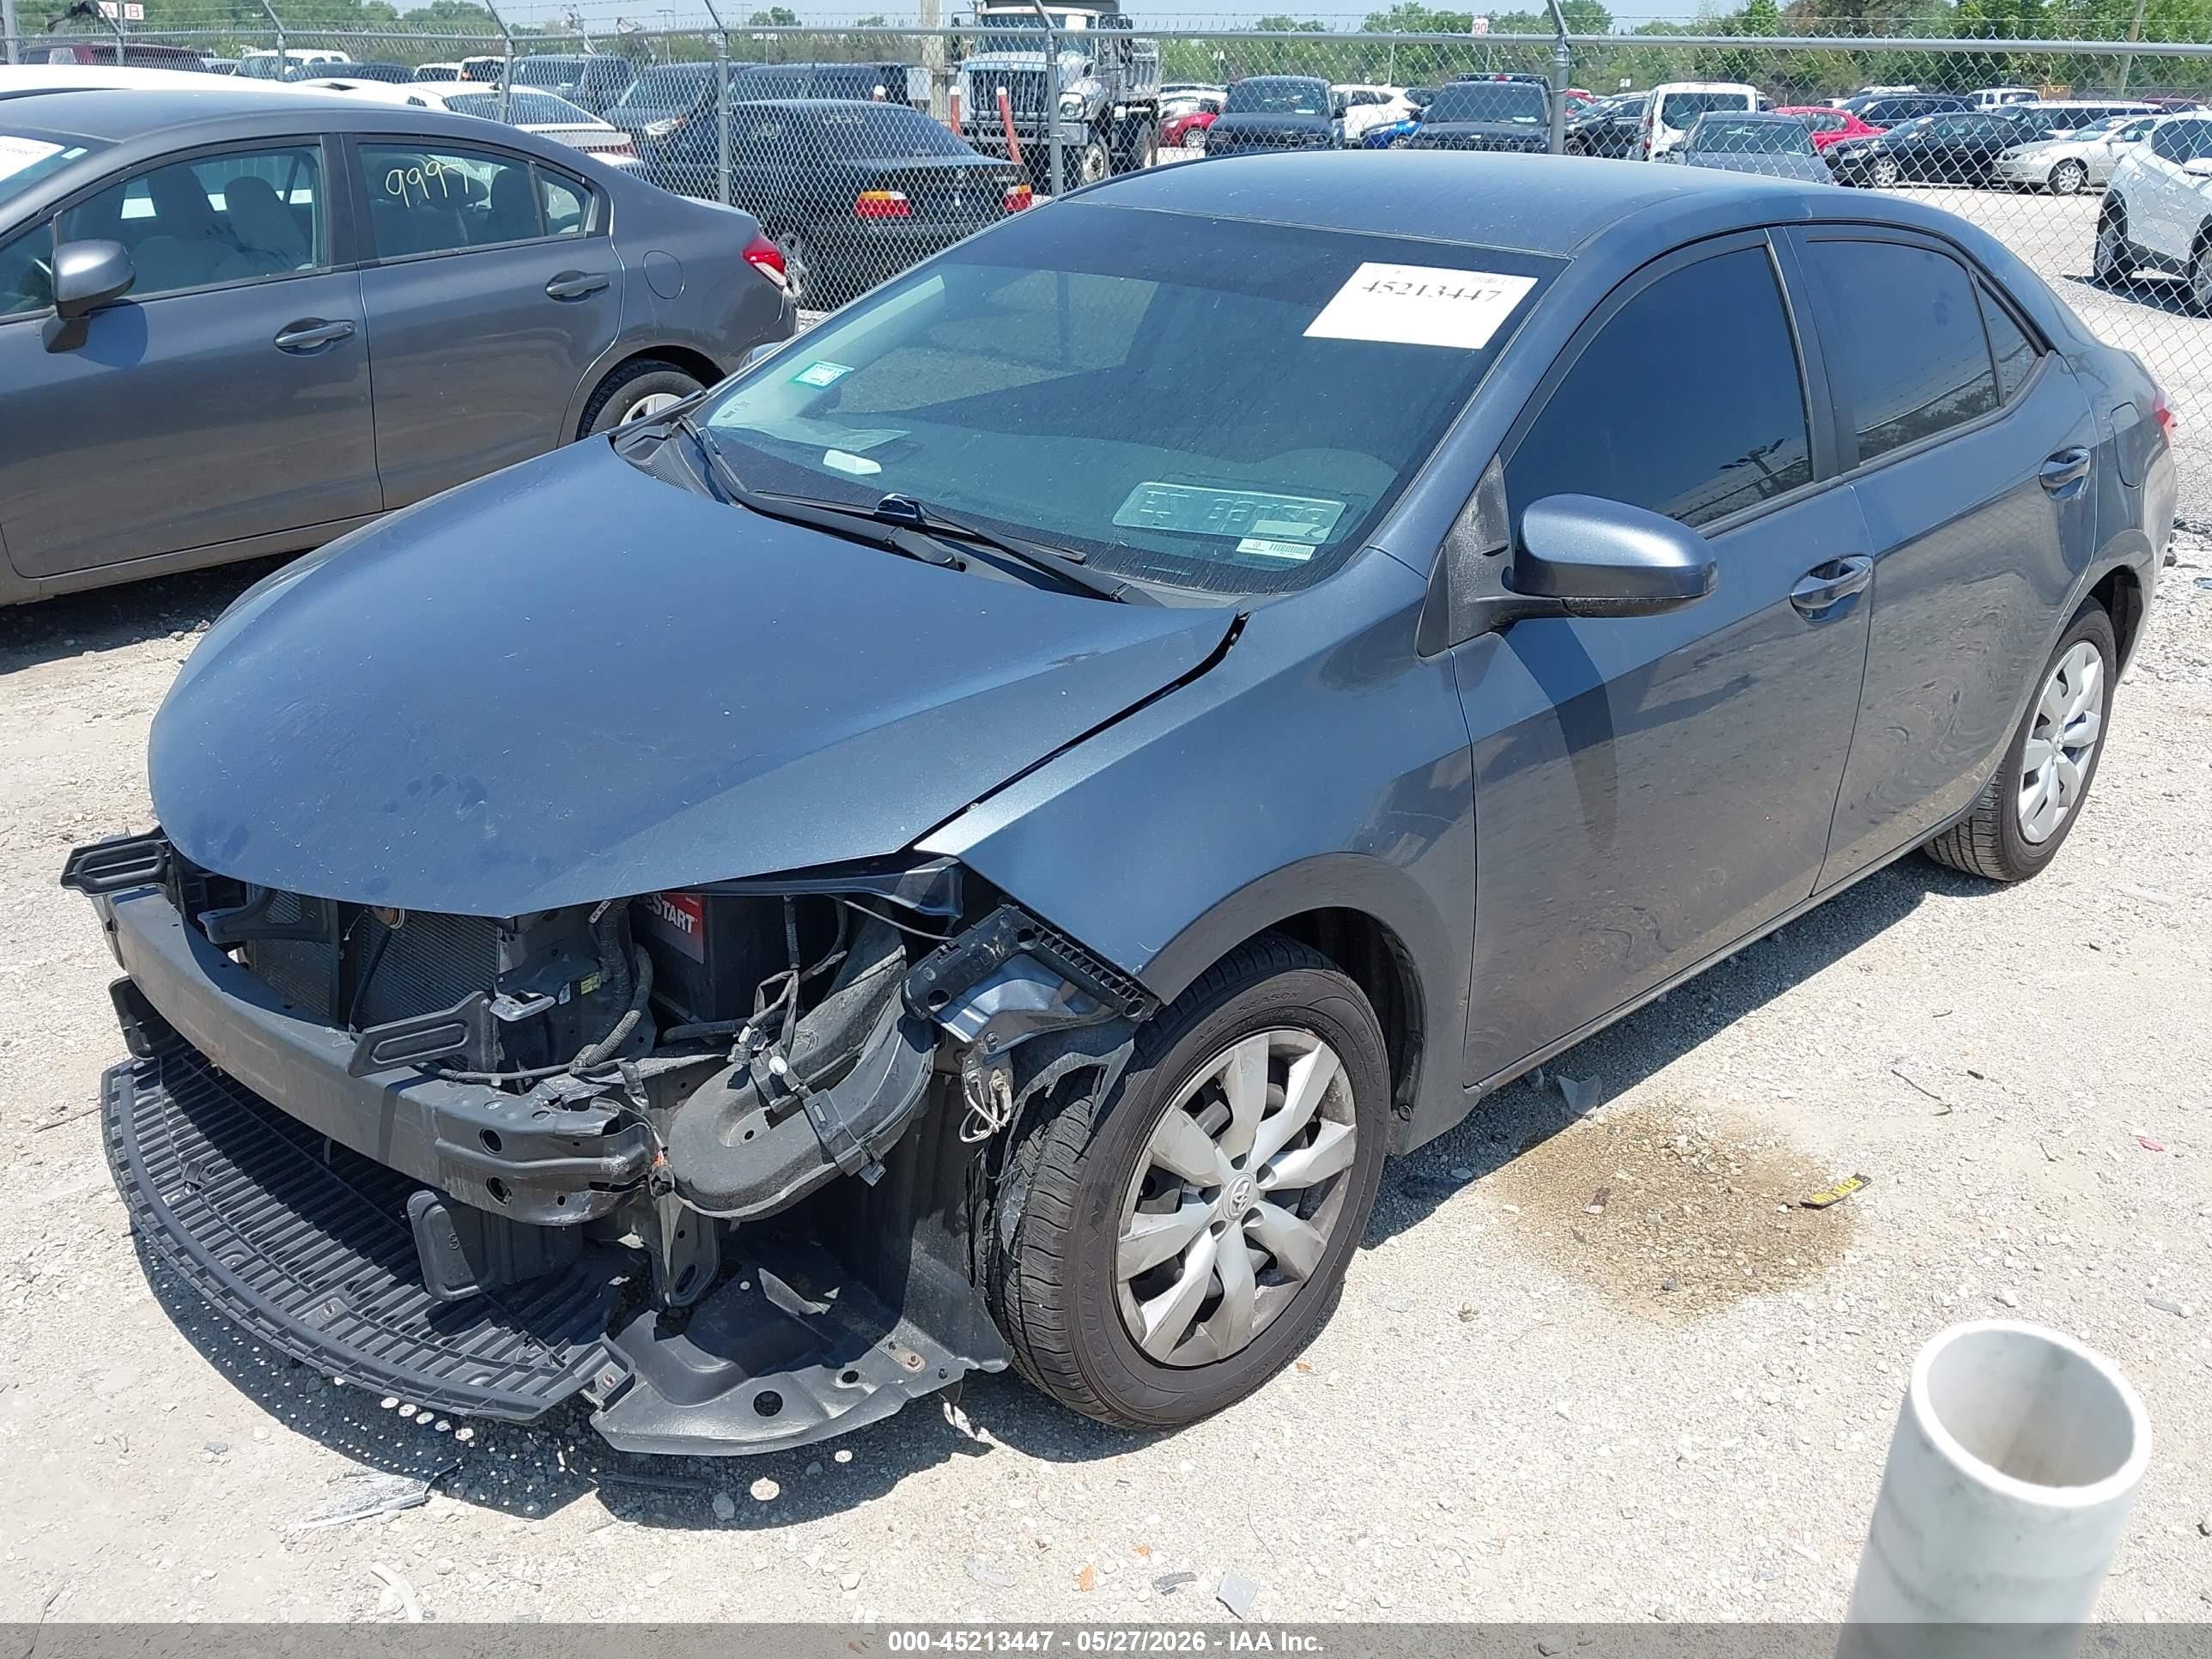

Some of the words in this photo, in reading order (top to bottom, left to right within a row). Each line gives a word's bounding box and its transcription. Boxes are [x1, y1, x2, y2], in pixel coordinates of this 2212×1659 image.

[128, 5, 140, 18] B
[1474, 22, 1486, 34] 90
[385, 161, 470, 208] 9997
[1361, 279, 1503, 302] 45213447
